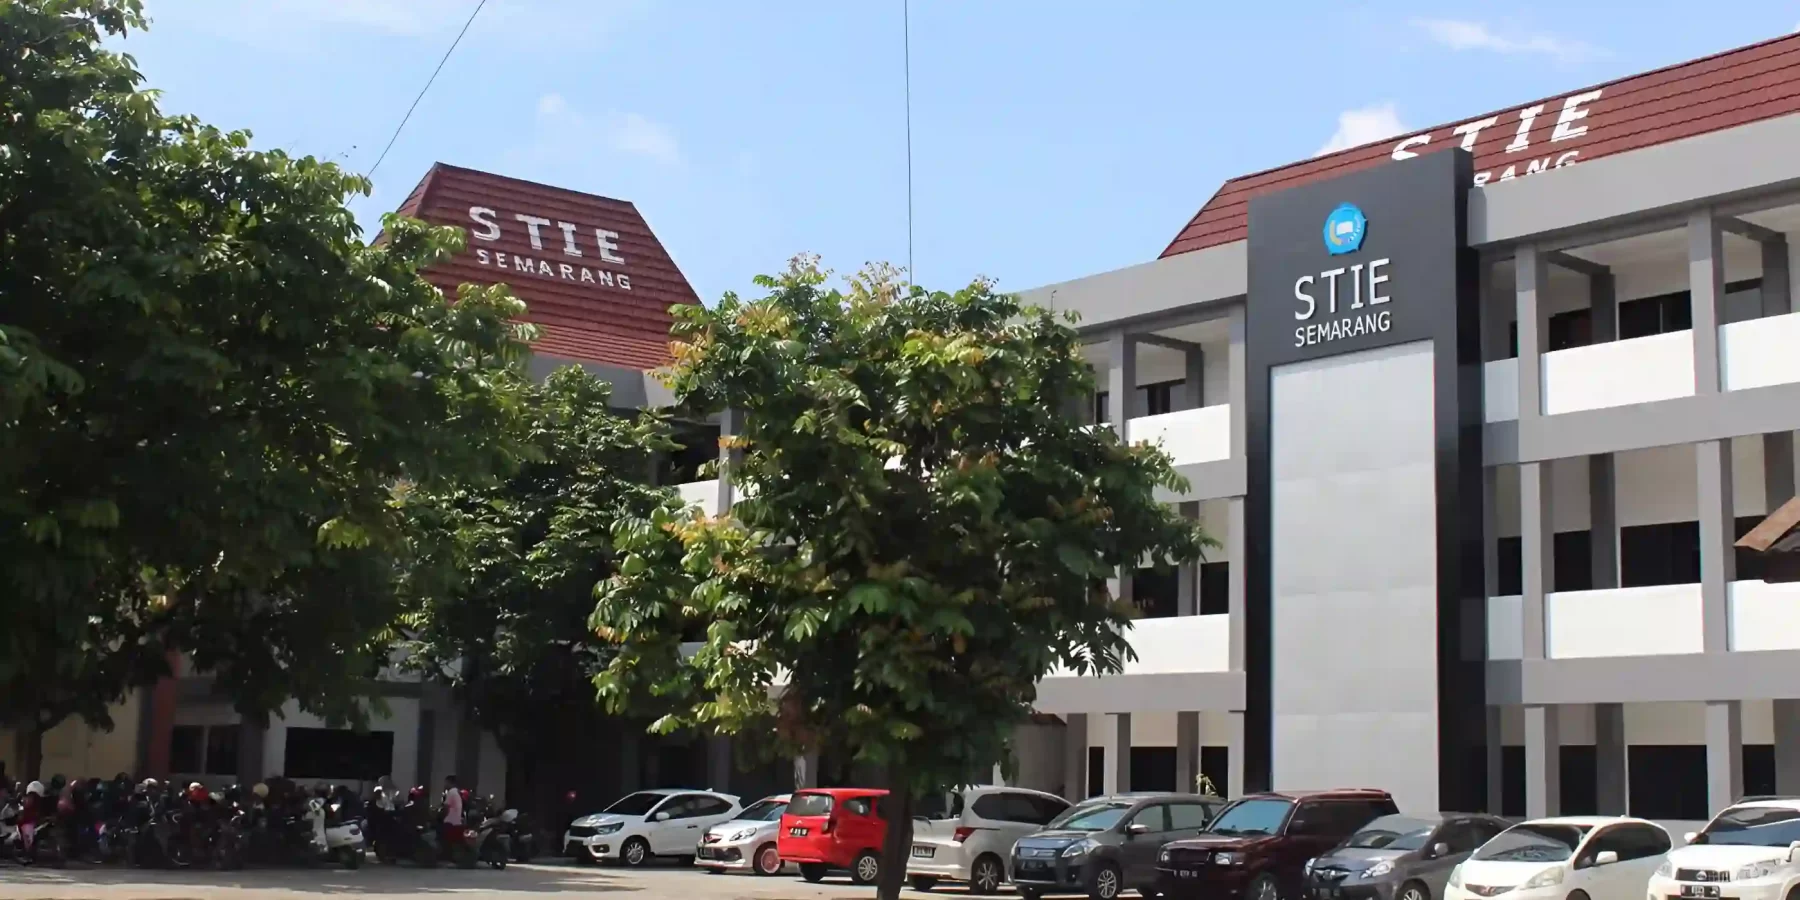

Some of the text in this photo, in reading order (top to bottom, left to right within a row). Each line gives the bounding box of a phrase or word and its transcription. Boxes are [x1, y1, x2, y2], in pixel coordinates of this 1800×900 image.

[469, 206, 625, 265] STIE
[476, 249, 632, 290] SEMARANG
[1294, 258, 1390, 320] STIE
[1294, 311, 1391, 347] SEMARANG
